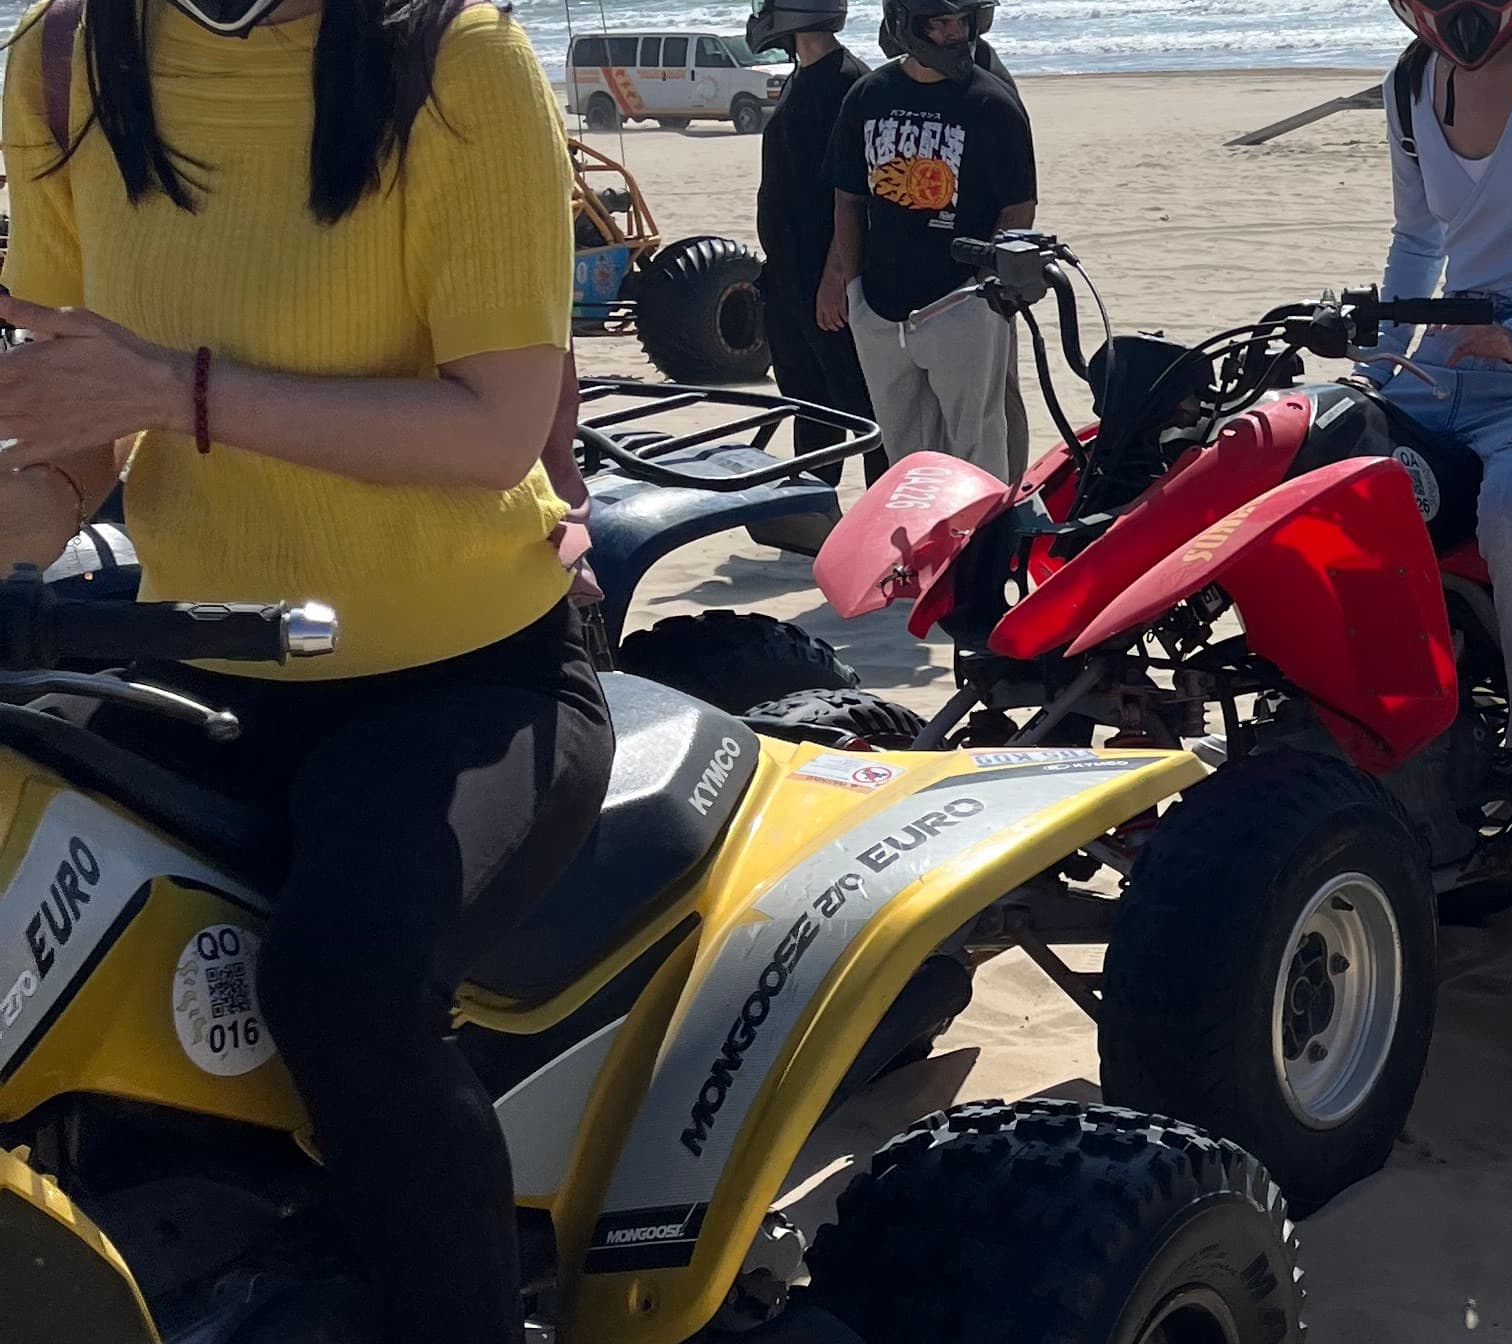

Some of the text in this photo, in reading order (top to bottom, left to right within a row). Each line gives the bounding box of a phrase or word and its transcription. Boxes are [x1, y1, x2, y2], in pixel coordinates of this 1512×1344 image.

[884, 466, 952, 510] QA226
[687, 736, 741, 816] KYMCO
[1072, 759, 1129, 769] KYMCO
[25, 836, 101, 980] EURO
[197, 927, 241, 960] QO
[680, 911, 820, 1158] MONGOOSE
[856, 798, 985, 873] EURO
[209, 1017, 260, 1054] 016
